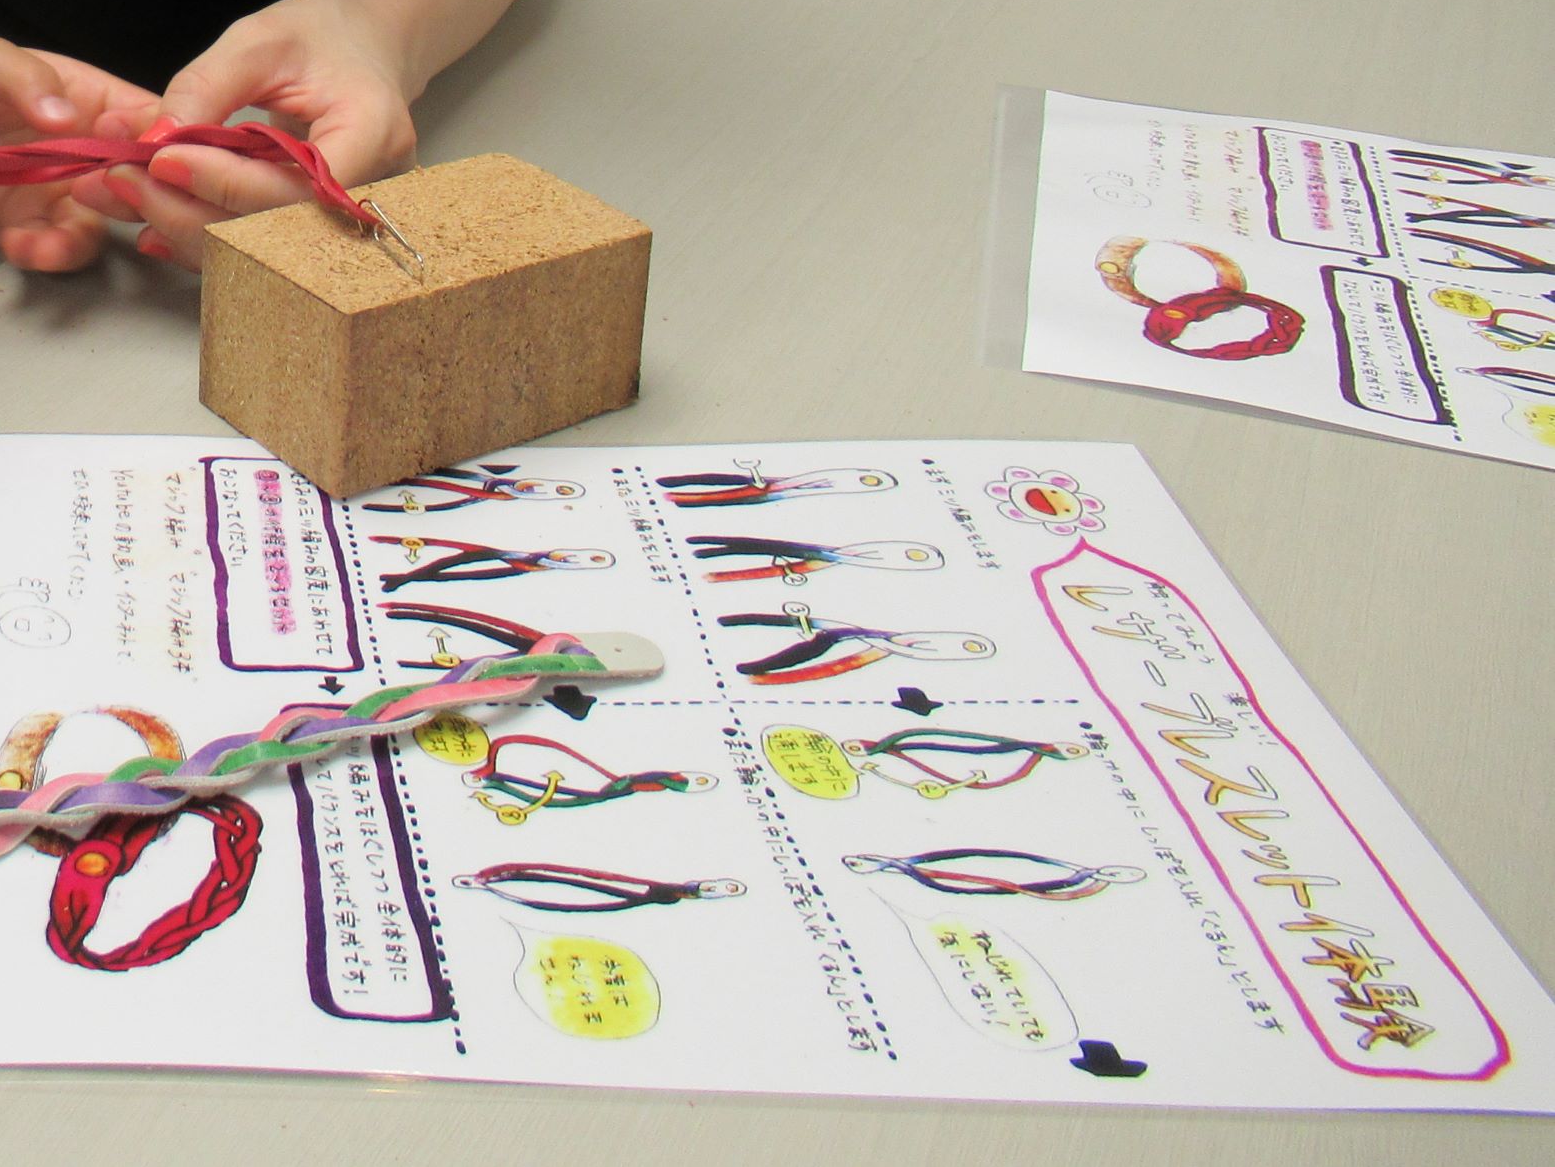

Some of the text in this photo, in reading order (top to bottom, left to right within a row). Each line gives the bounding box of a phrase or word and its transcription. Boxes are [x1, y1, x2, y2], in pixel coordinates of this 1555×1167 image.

[1060, 584, 1434, 1052] レザーブレスレット体験
